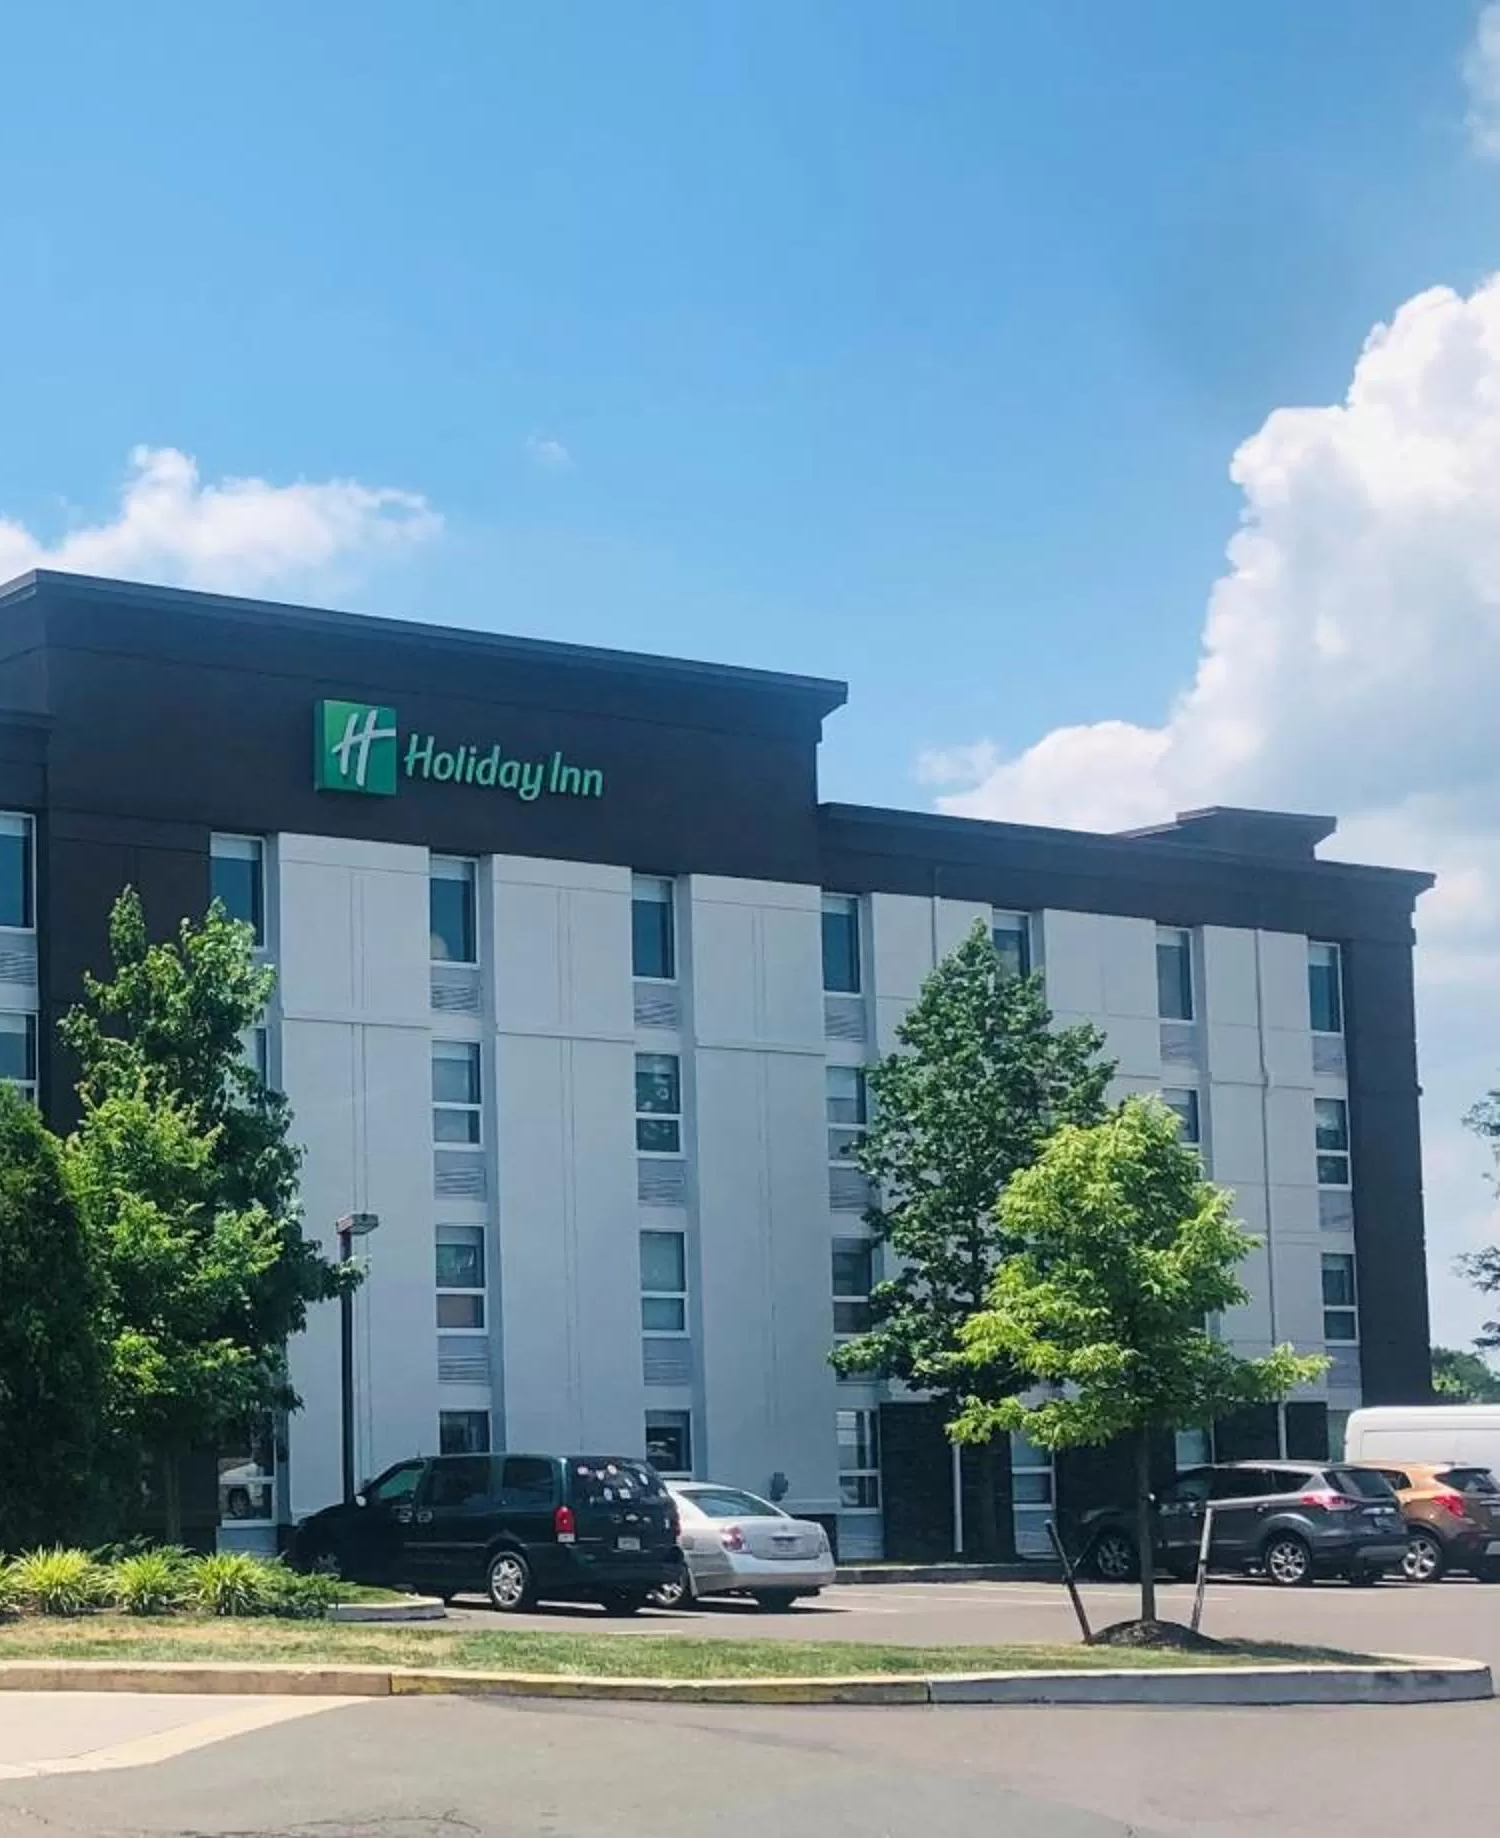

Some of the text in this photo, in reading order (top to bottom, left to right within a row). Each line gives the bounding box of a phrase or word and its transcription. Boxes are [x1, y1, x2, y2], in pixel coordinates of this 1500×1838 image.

[331, 709, 396, 786] H
[404, 733, 603, 801] Holiday Inn
